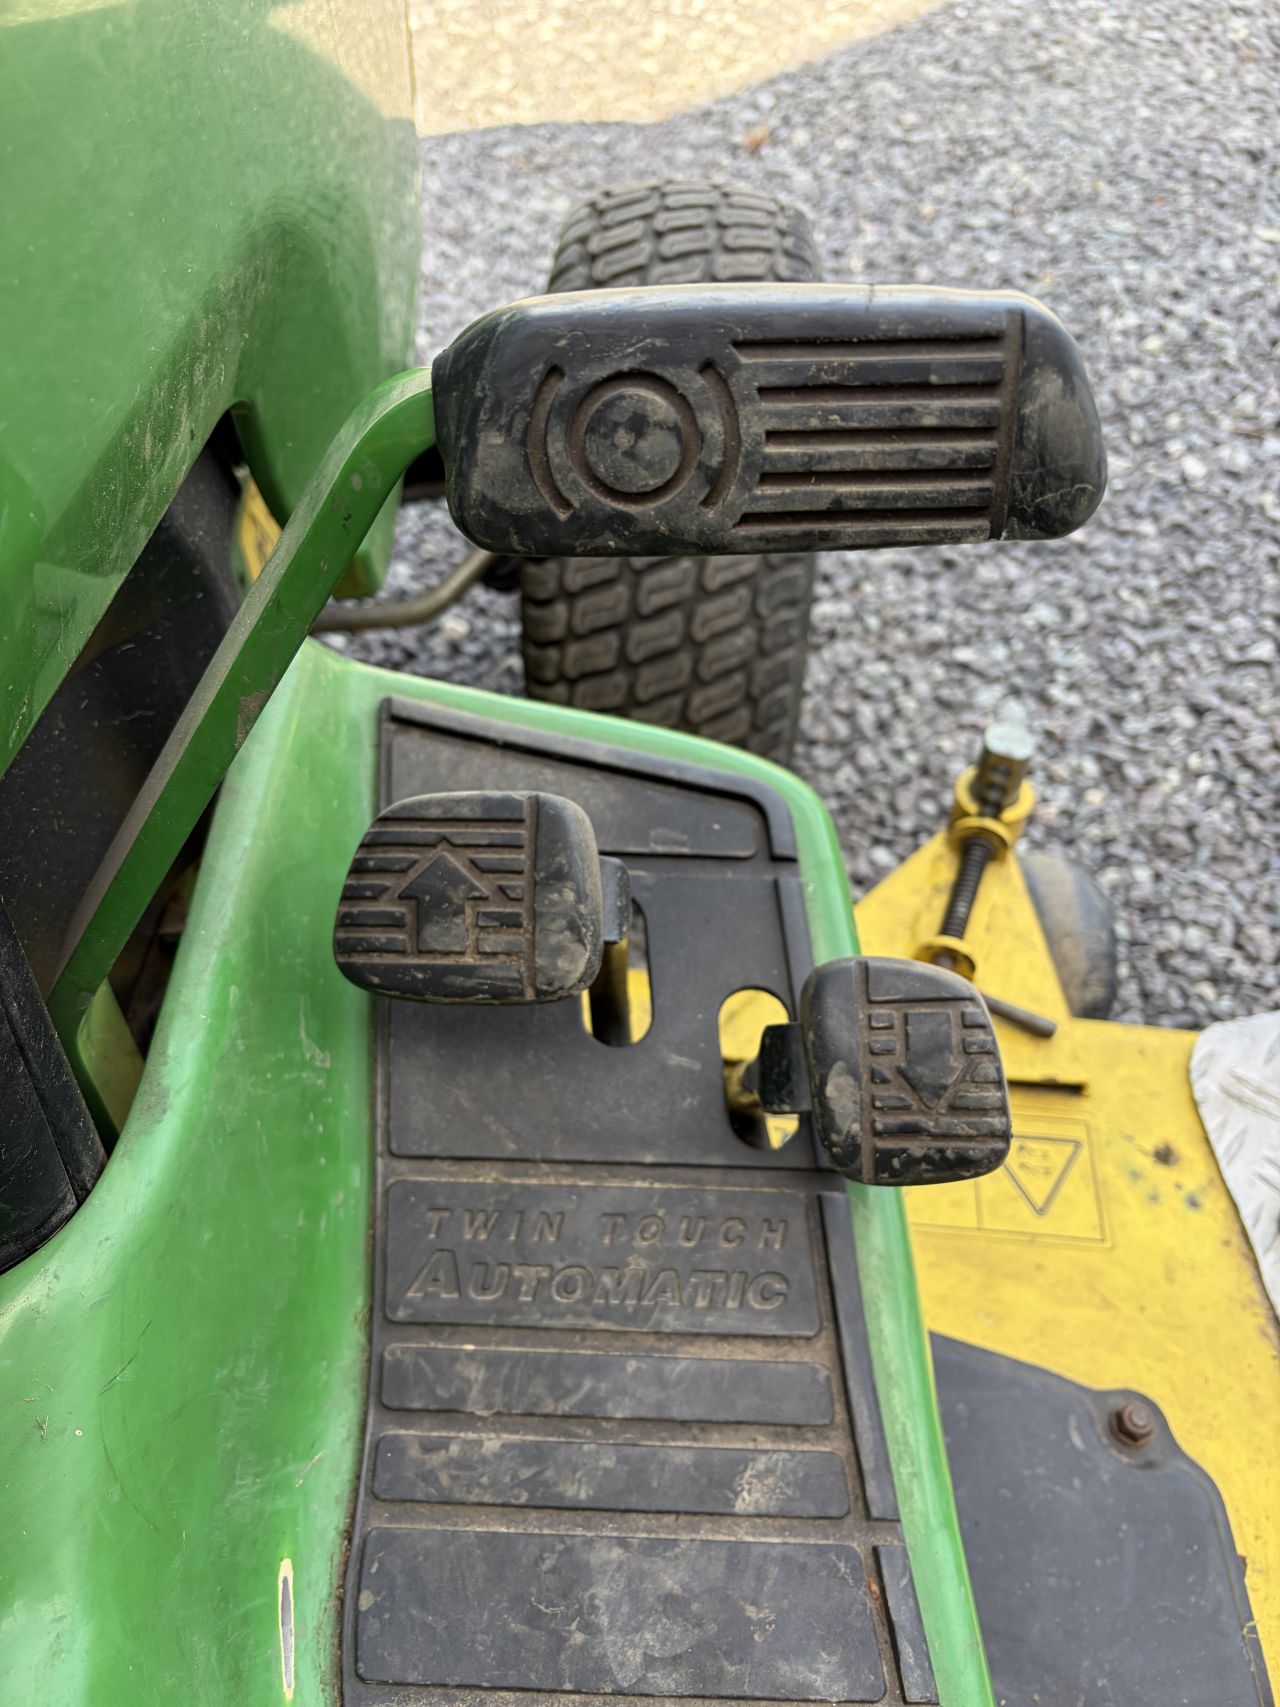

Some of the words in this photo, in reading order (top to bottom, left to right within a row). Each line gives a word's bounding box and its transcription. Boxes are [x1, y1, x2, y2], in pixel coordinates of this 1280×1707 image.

[425, 1207, 565, 1243] TWIN
[601, 1212, 789, 1249] TOUCH
[405, 1249, 791, 1310] AUTOMATIC
